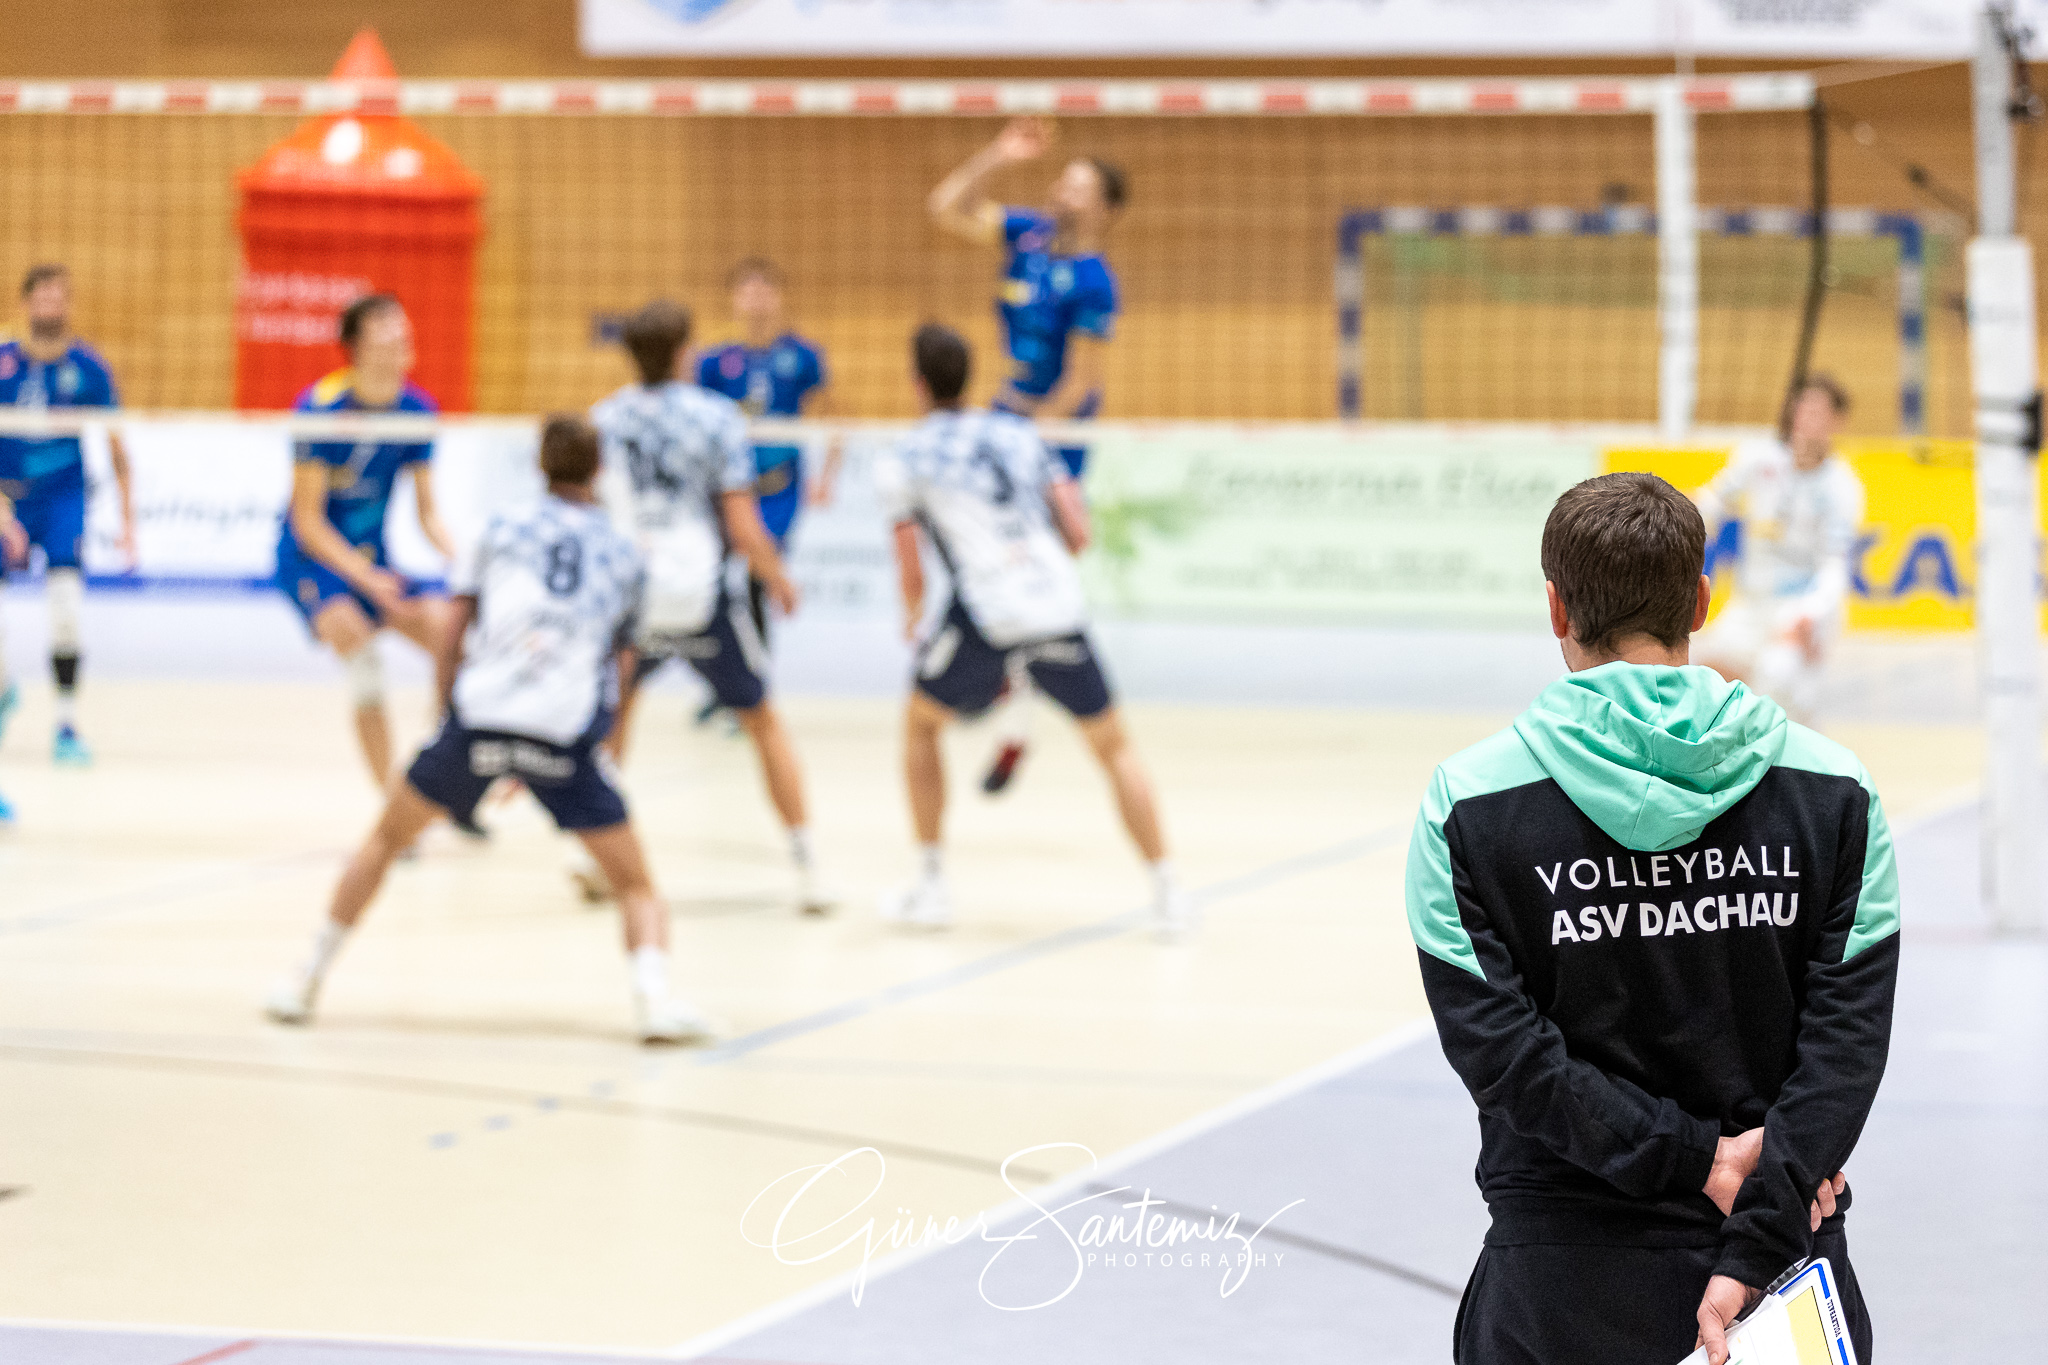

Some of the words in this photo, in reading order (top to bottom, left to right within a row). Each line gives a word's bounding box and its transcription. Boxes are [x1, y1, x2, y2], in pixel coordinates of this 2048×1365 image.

[546, 533, 583, 598] 8
[1534, 844, 1800, 895] VOLLEYBALL
[1551, 903, 1629, 945] ASV
[1639, 892, 1799, 937] DACHAU
[1826, 1299, 1841, 1338] VOLLEYBALL
